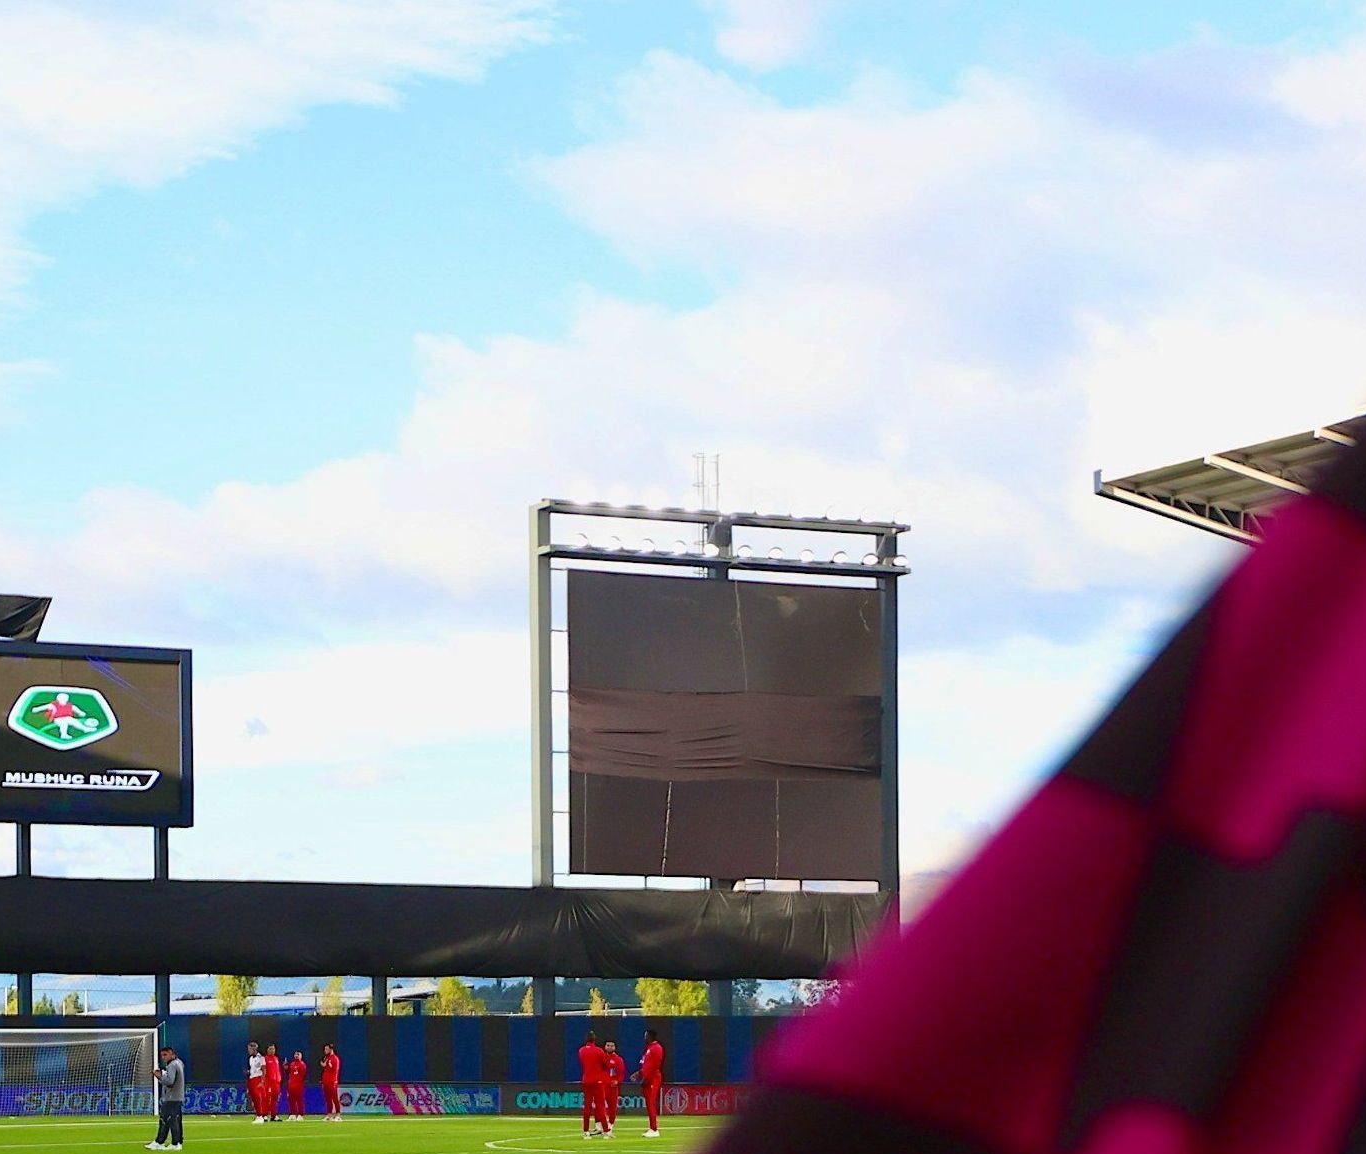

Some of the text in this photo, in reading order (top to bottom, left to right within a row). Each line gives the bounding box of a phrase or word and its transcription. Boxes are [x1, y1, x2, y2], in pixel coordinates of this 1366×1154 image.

[5, 771, 142, 787] MUSHUC RUNA
[693, 1091, 729, 1111] MG
